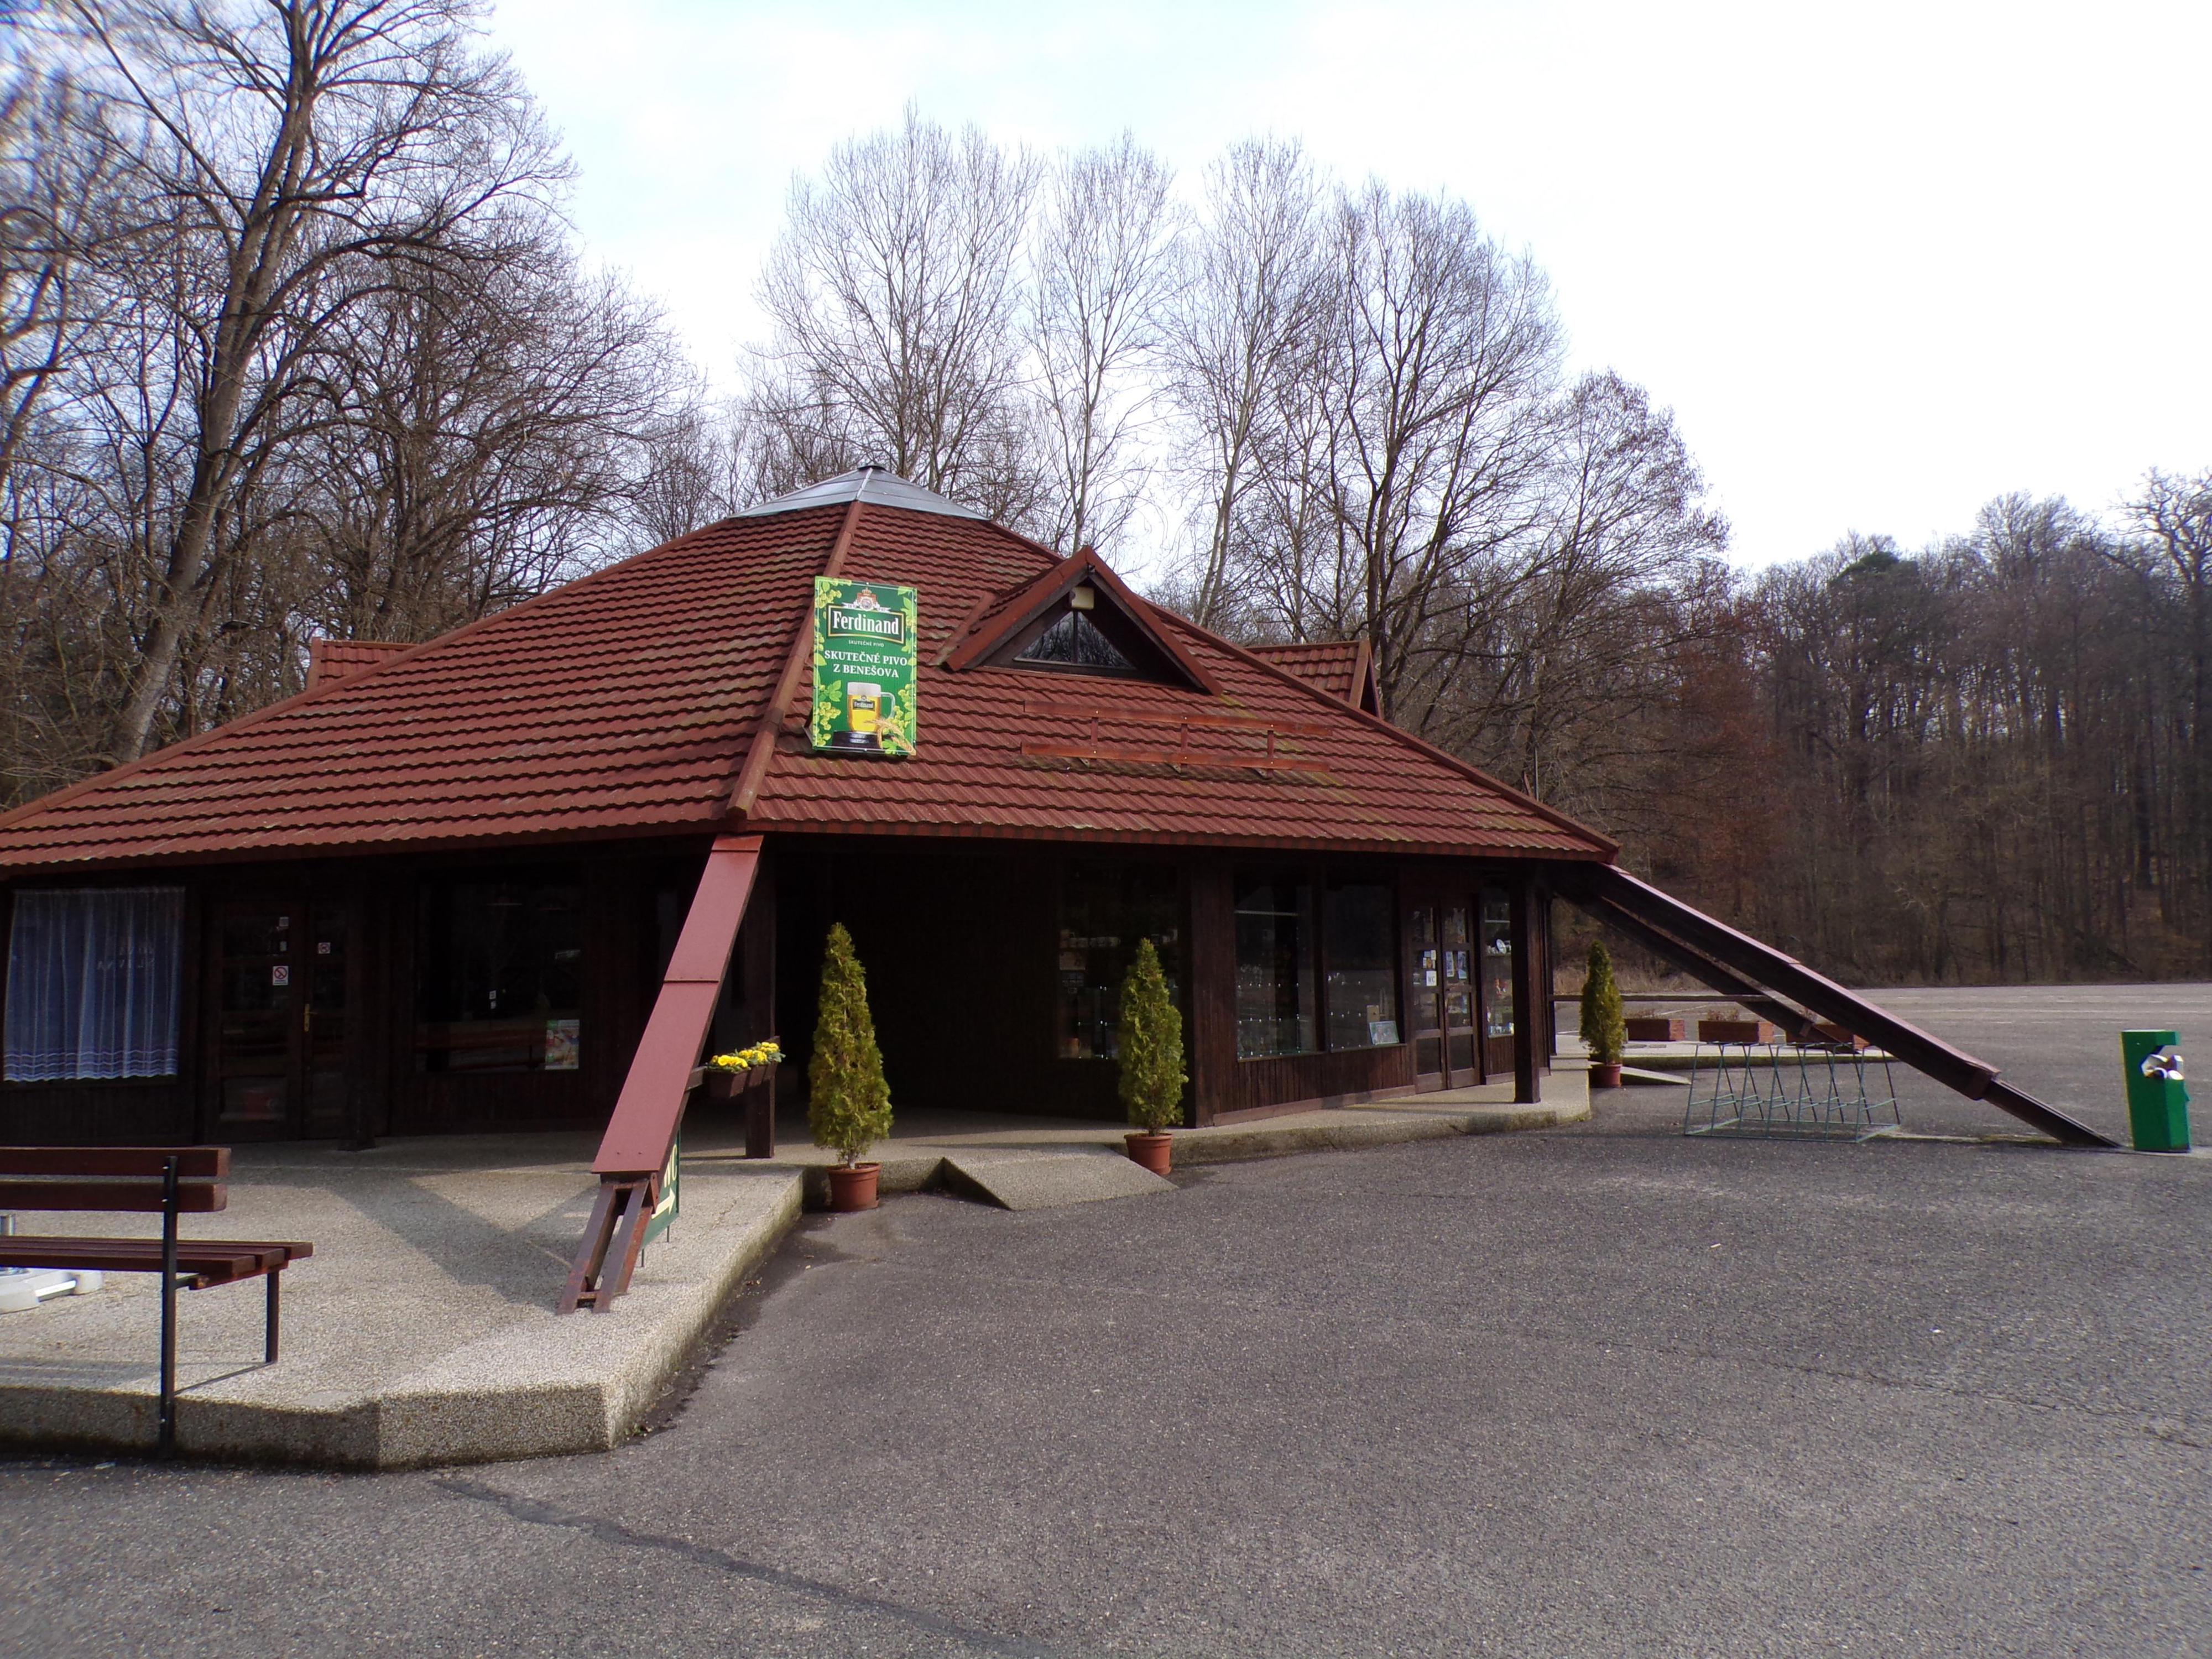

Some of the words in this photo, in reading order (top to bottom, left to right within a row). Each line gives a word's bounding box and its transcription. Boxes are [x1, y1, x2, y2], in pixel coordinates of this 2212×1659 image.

[832, 610, 900, 635] Ferdinand
[824, 650, 881, 664] SKUTEČNÉ
[883, 655, 908, 666] PIVO
[833, 664, 841, 673] Z
[843, 664, 899, 678] BENEŠOVA
